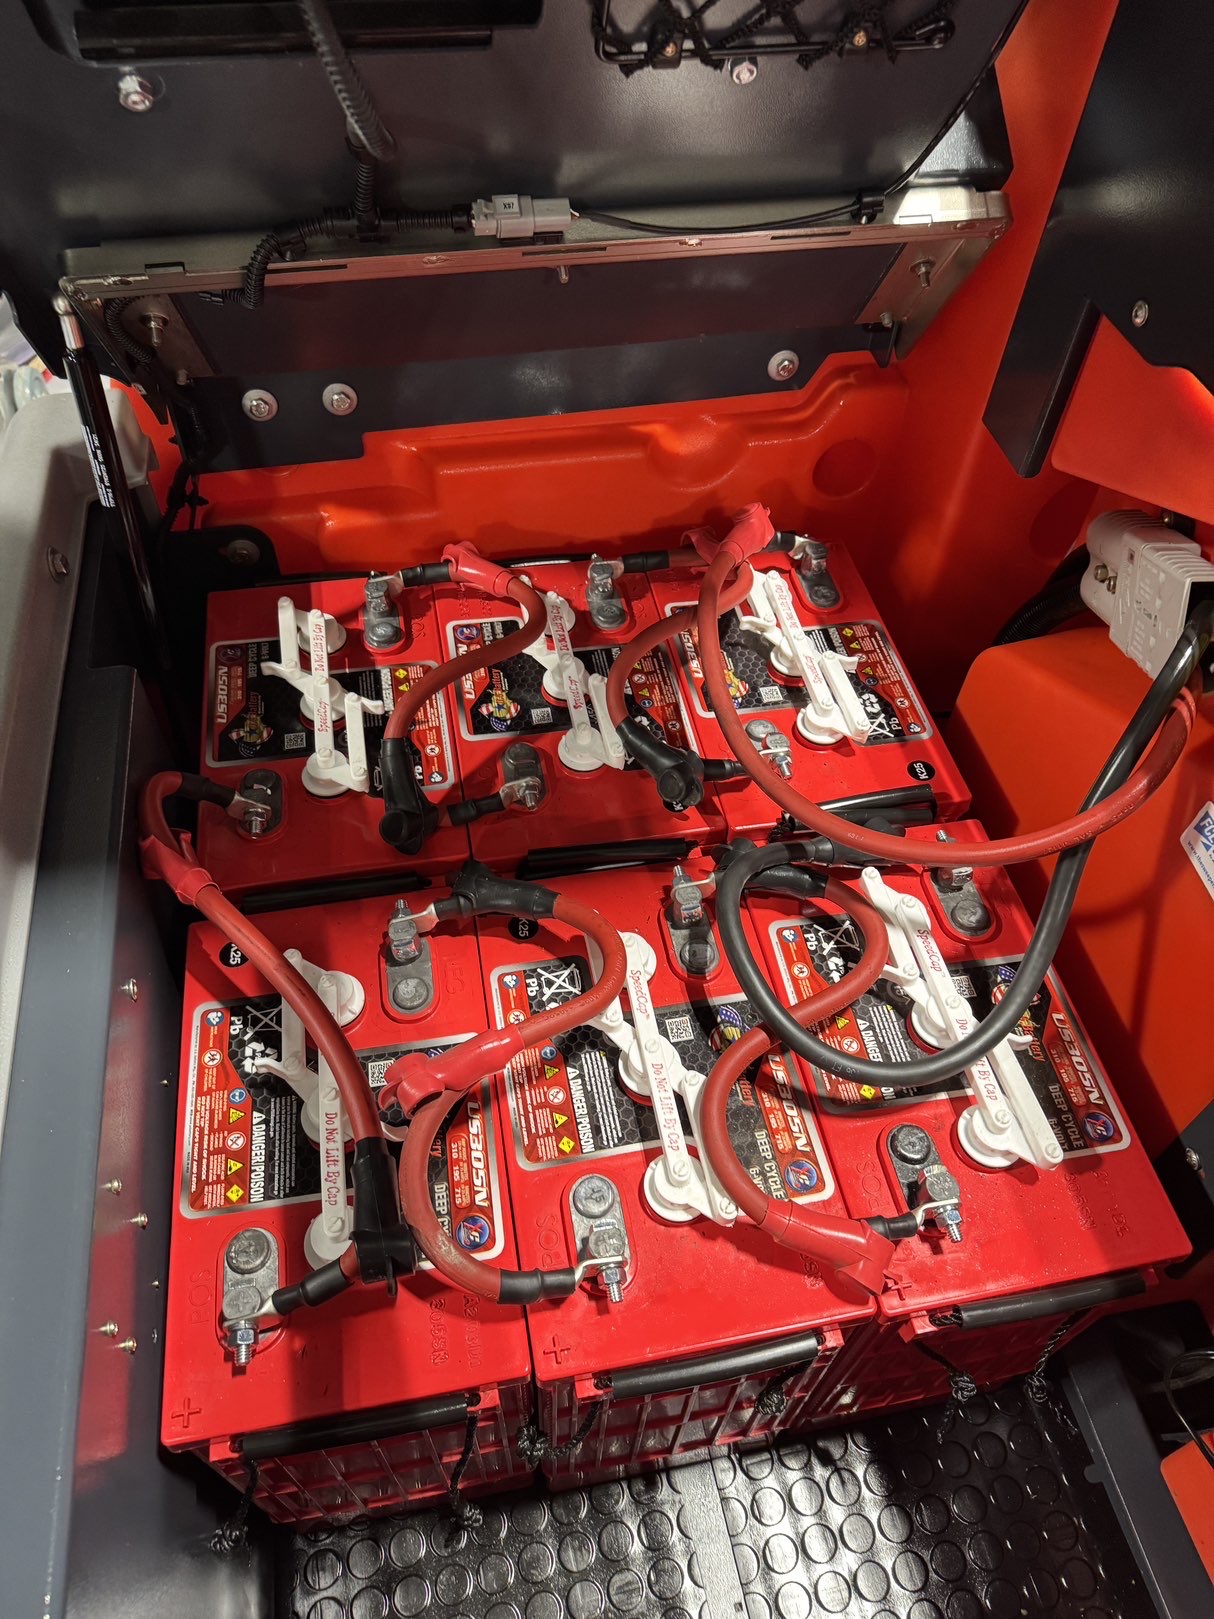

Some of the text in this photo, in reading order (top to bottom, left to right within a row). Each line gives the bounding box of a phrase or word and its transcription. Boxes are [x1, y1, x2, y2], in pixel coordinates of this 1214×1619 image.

[248, 644, 257, 678] DEEP CYCLE
[889, 717, 902, 730] Pb
[913, 763, 929, 780] K25
[518, 918, 529, 937] K25
[804, 933, 818, 950] Pb
[918, 929, 943, 972] SpeedCap
[526, 978, 539, 996] Pb
[630, 969, 648, 1015] SpeedCap
[230, 1016, 243, 1035] Pb
[956, 1018, 969, 1030] Do
[978, 1070, 992, 1081] By
[1051, 1012, 1104, 1104] US305N
[1060, 1068, 1070, 1083] 195
[652, 1063, 680, 1152] Do Not Lift By Cap
[768, 1054, 810, 1152] US305N
[984, 1084, 998, 1101] Cap
[569, 1079, 595, 1153] DANGER/POISON
[761, 1092, 784, 1149] 310 195 715
[1048, 1084, 1084, 1148] DEEP CYCLE
[251, 1124, 266, 1202] DANGER/POISON
[325, 1112, 340, 1206] Do Not Lift By Cap
[467, 1101, 489, 1206] US305N
[754, 1129, 785, 1199] DEEP CYCLE
[434, 1184, 448, 1214] DEEP
[188, 1269, 212, 1325] POS
